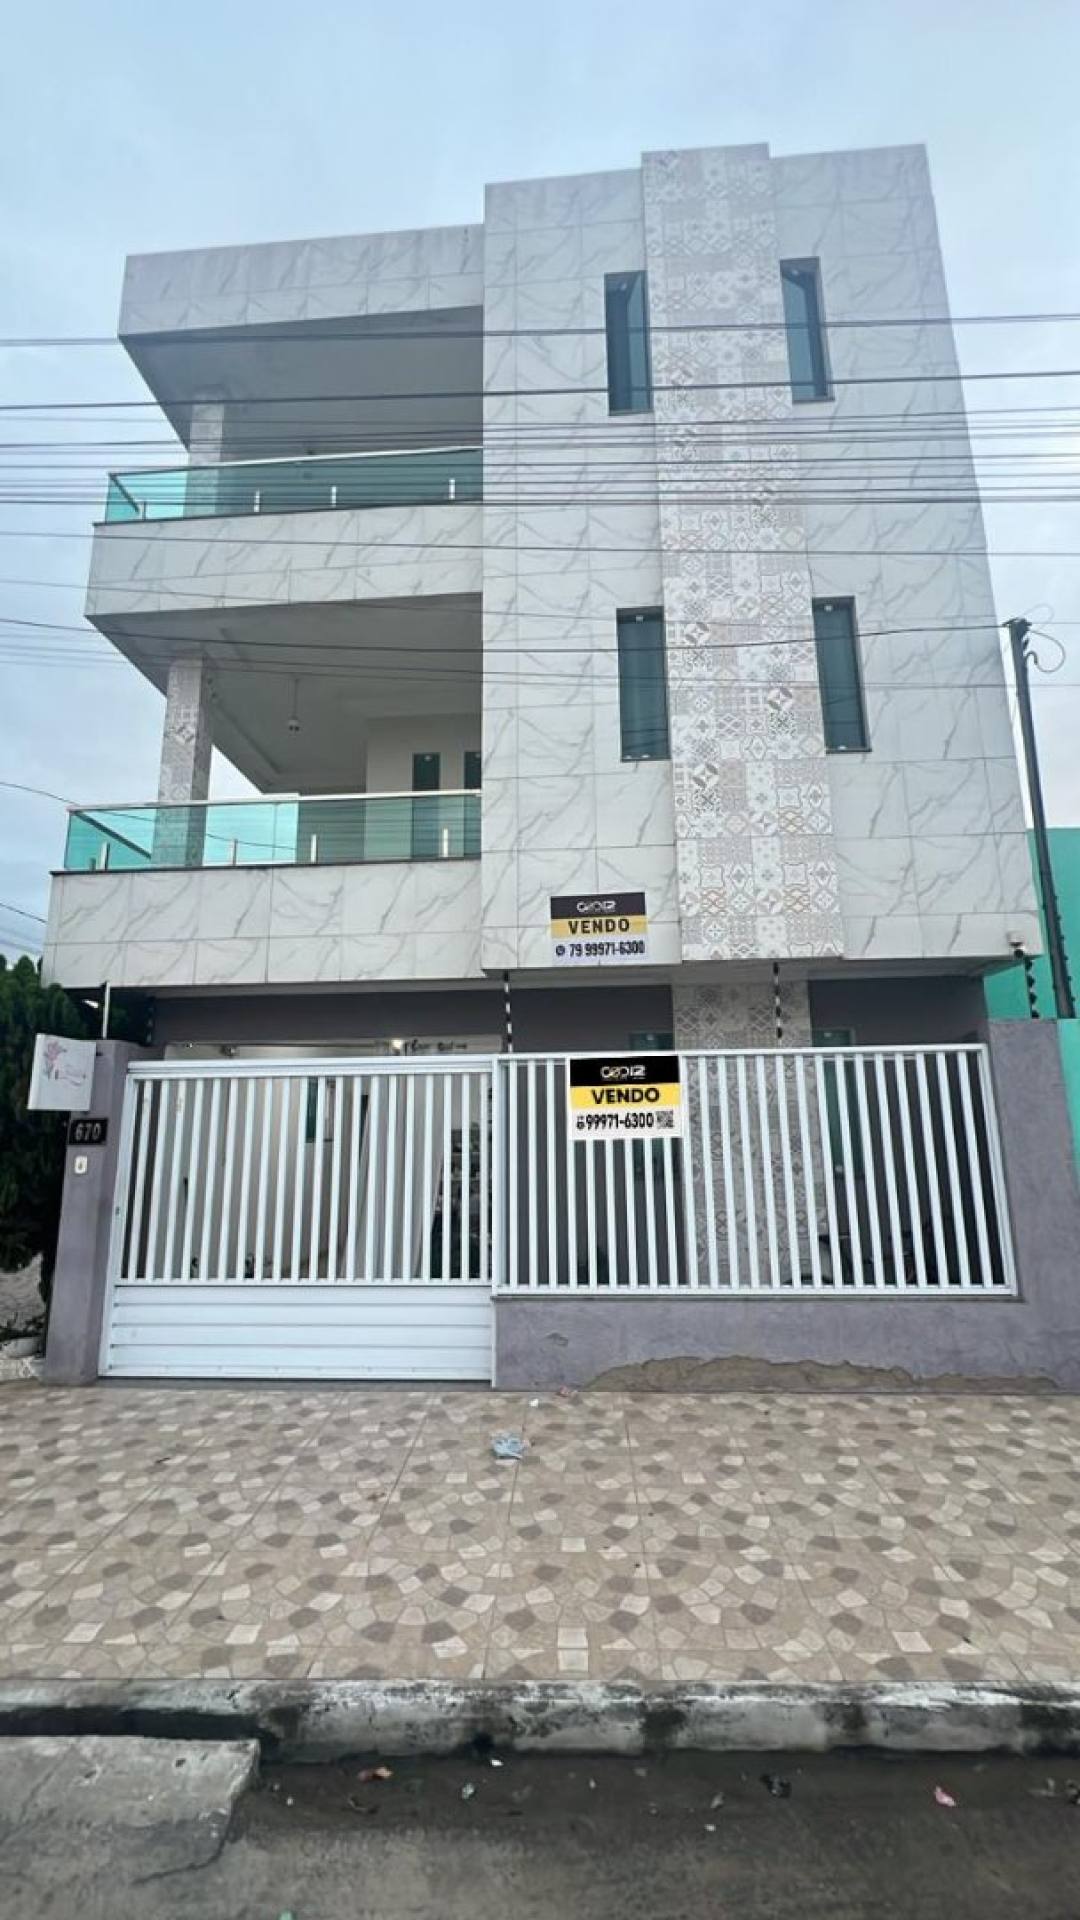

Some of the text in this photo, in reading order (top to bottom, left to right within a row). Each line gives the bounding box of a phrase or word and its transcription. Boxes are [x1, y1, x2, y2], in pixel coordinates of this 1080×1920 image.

[568, 918, 630, 935] VENDO
[584, 940, 645, 957] 99971-6300
[591, 1087, 660, 1105] VENDO
[585, 1111, 655, 1131] 99971-6300
[75, 1122, 102, 1141] 670
